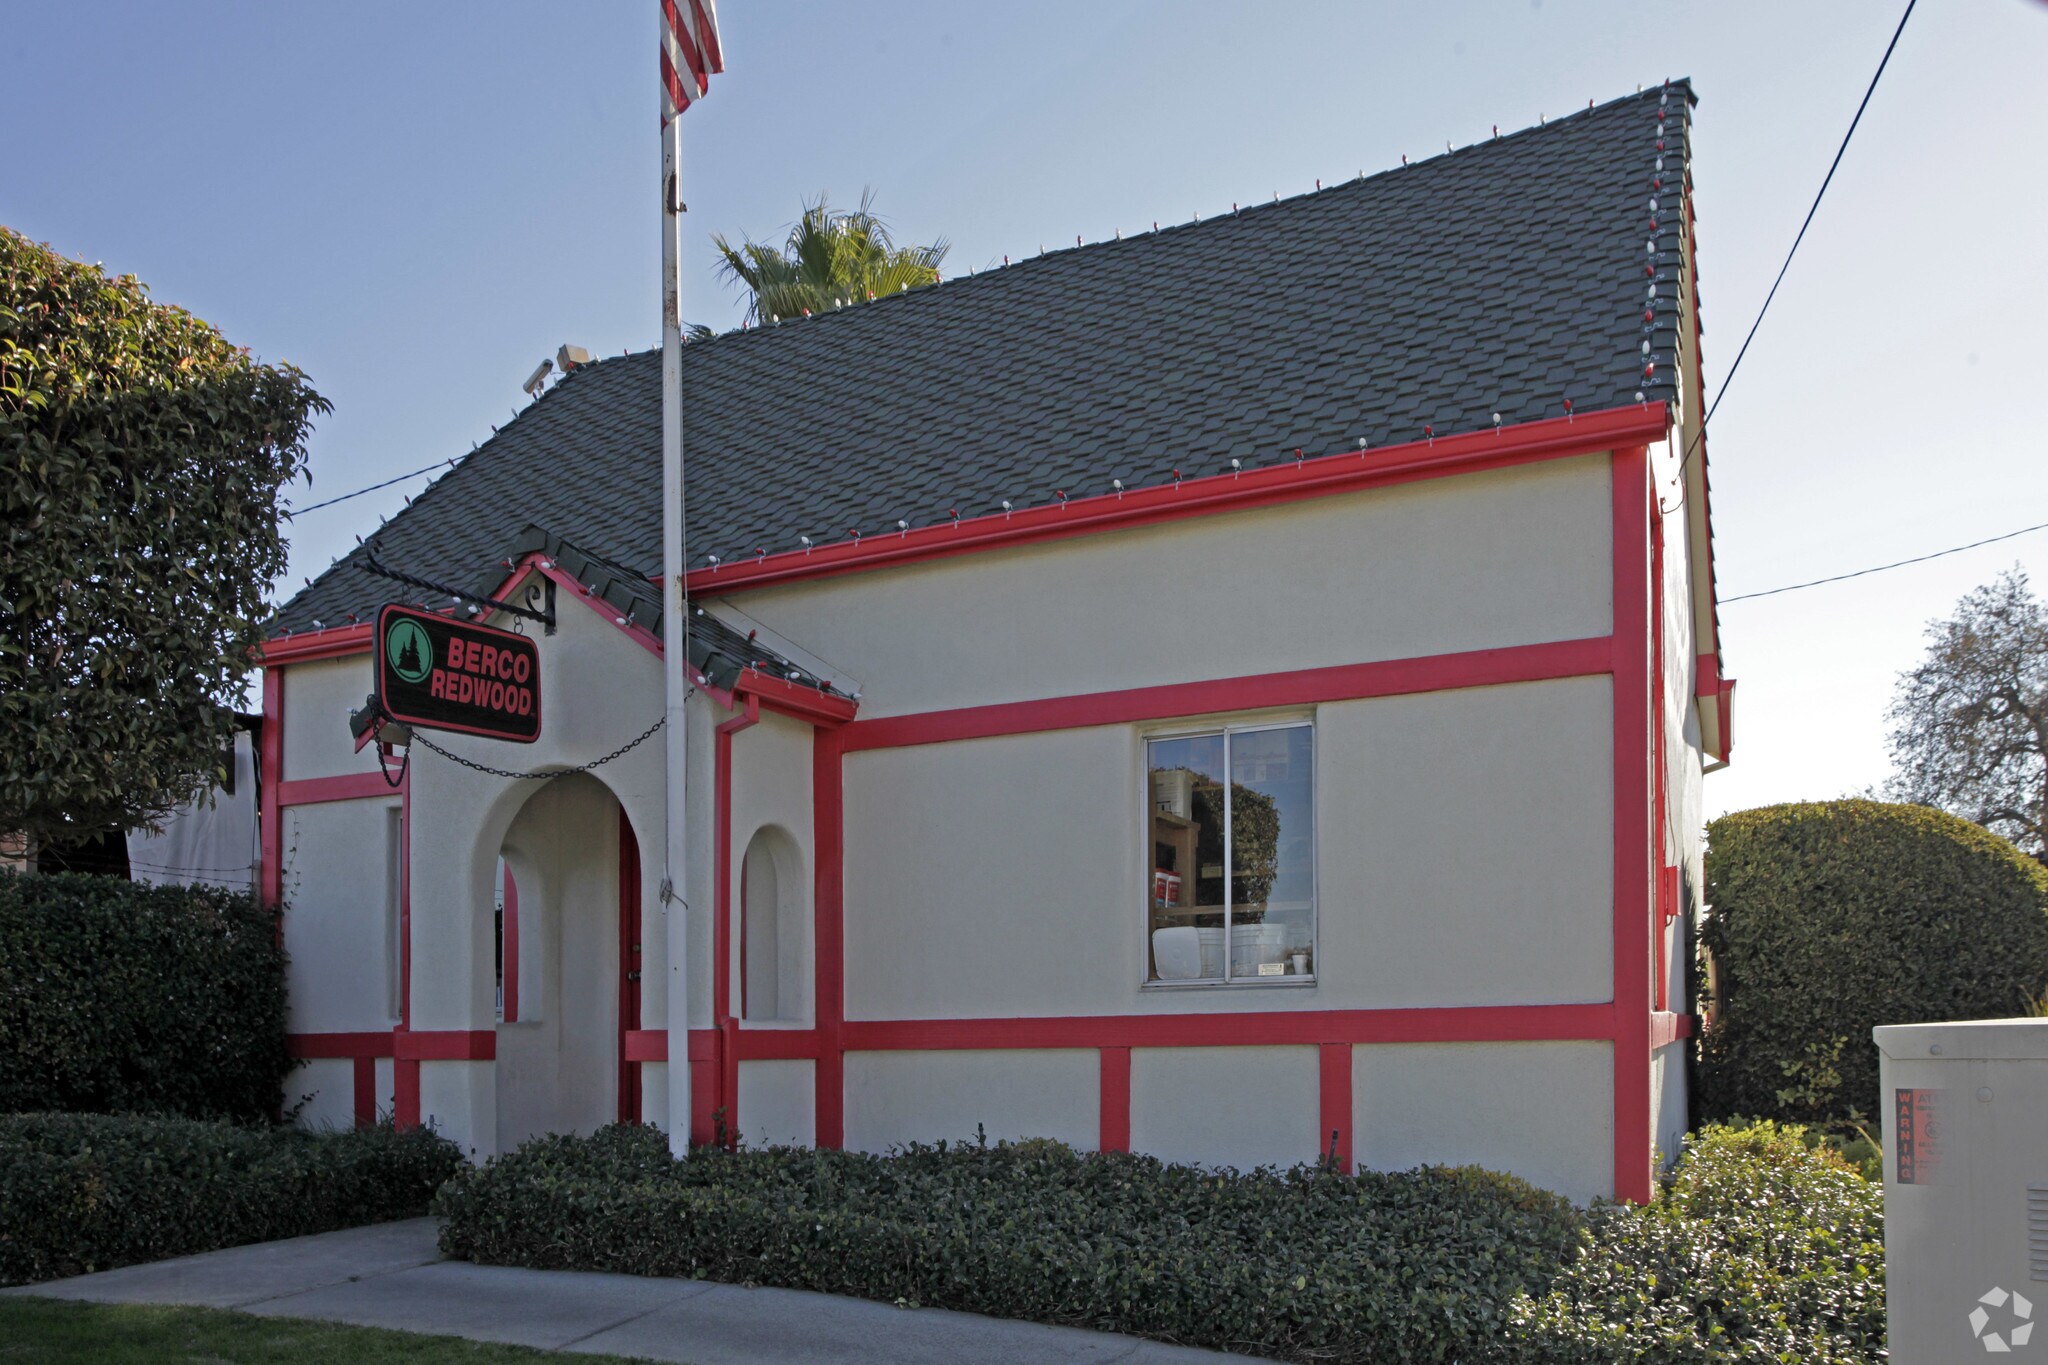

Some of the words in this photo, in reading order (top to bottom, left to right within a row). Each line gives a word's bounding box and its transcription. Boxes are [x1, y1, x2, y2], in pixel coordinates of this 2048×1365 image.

[447, 637, 530, 683] BERCO
[431, 668, 531, 716] REDWOOD
[1899, 1093, 1912, 1178] WARNING
